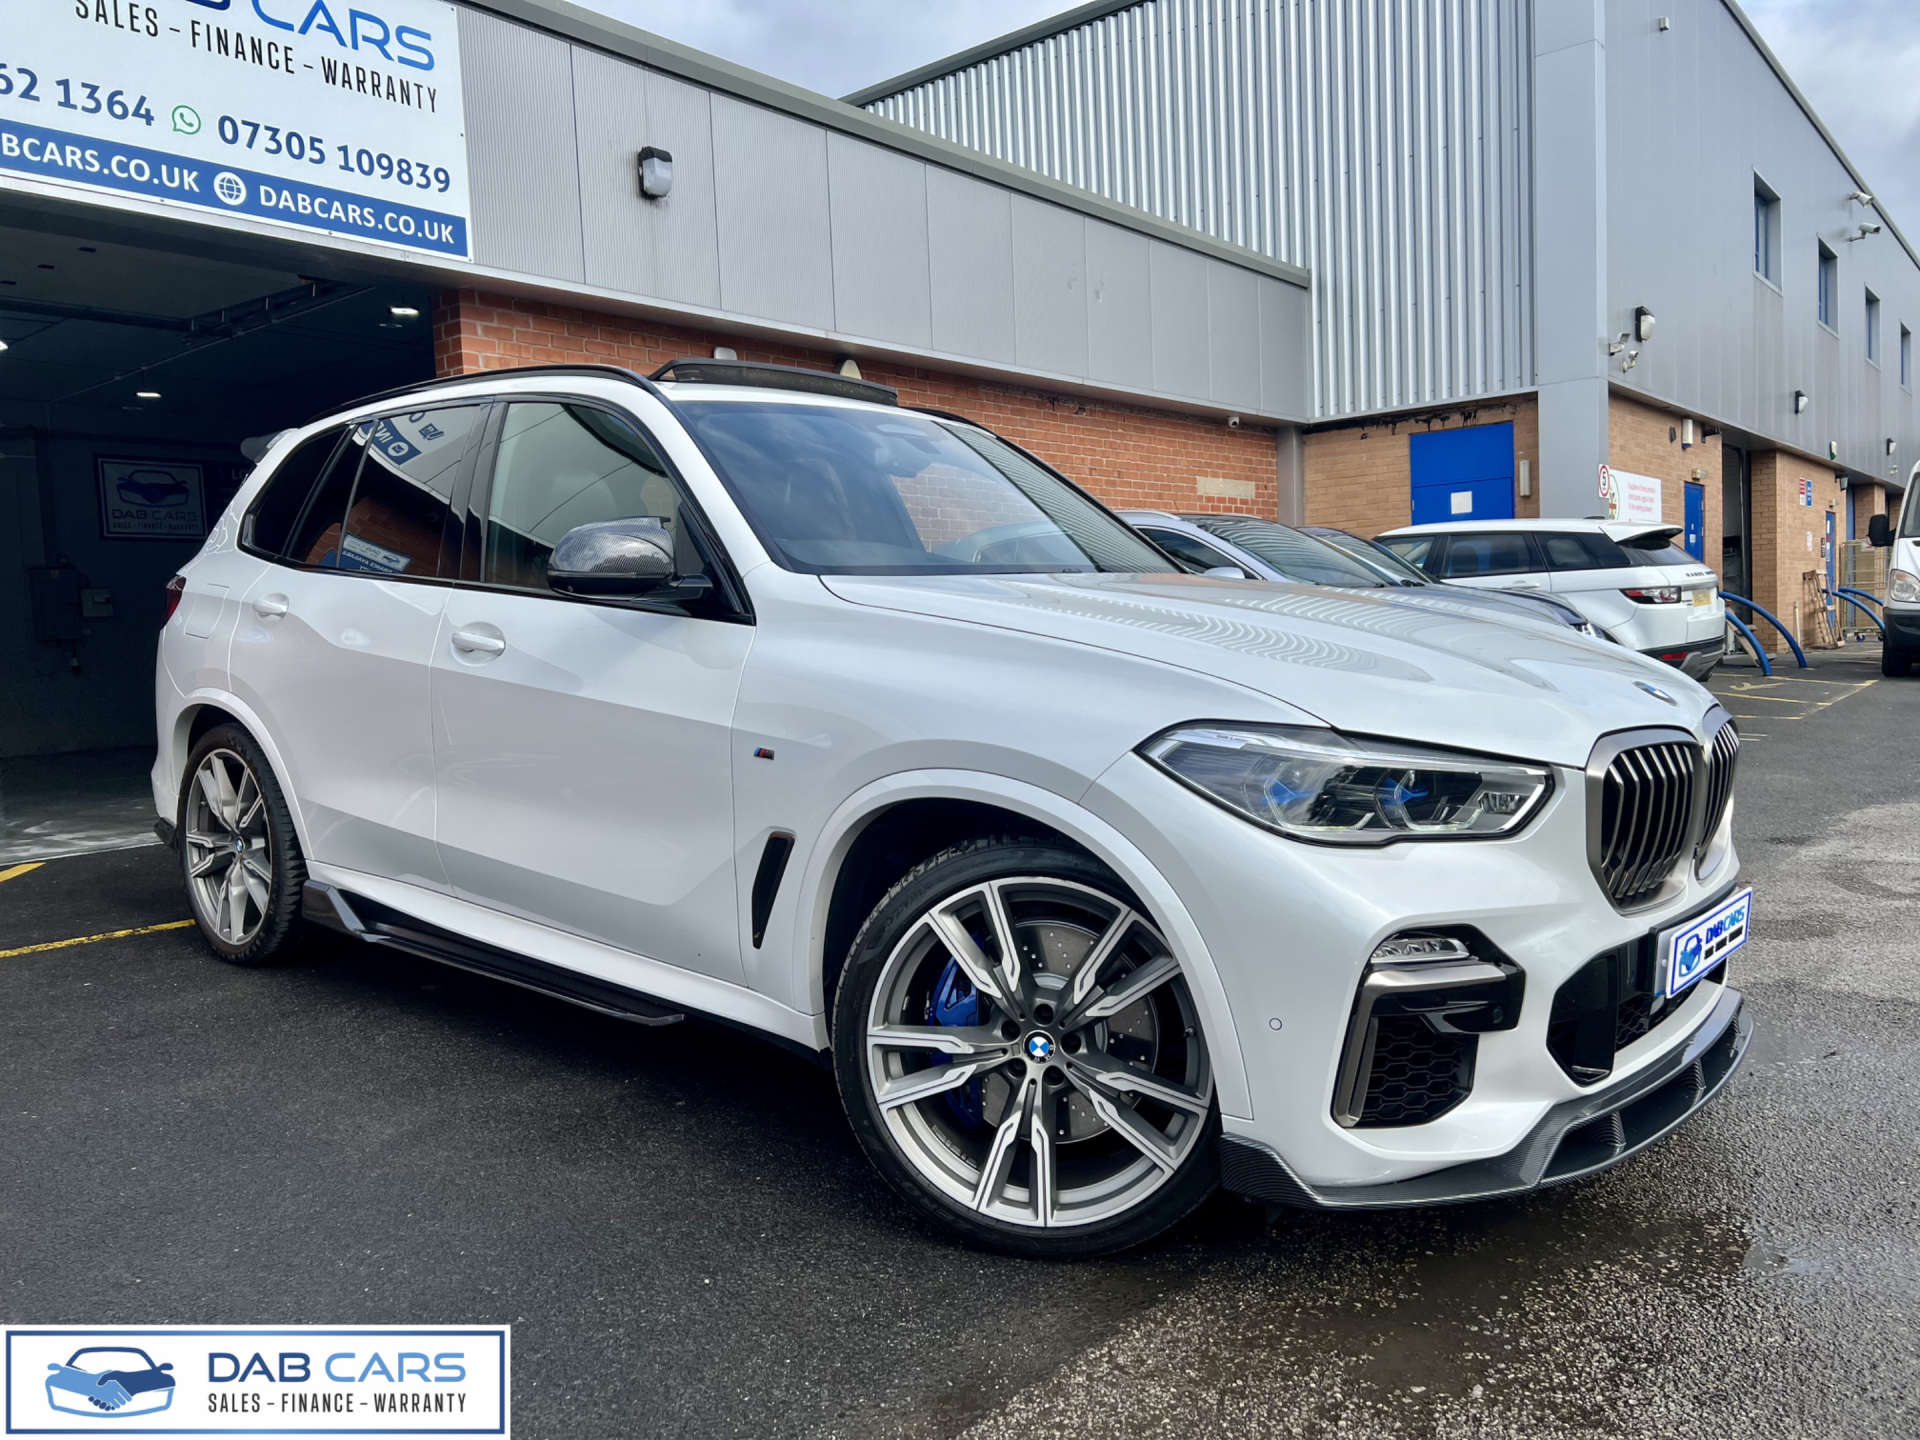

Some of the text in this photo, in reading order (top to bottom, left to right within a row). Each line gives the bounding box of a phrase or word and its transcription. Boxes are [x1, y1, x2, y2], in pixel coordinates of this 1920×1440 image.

[75, 0, 159, 38] SALES
[191, 20, 295, 74] FINANCE
[321, 56, 437, 113] WARRANTY
[56, 78, 154, 126] 1364
[1, 132, 200, 193] BCARS.CO.UK
[217, 114, 451, 193] 07305 109839
[259, 185, 454, 244] DABCARS.CO.UK
[1705, 920, 1723, 944] DAB
